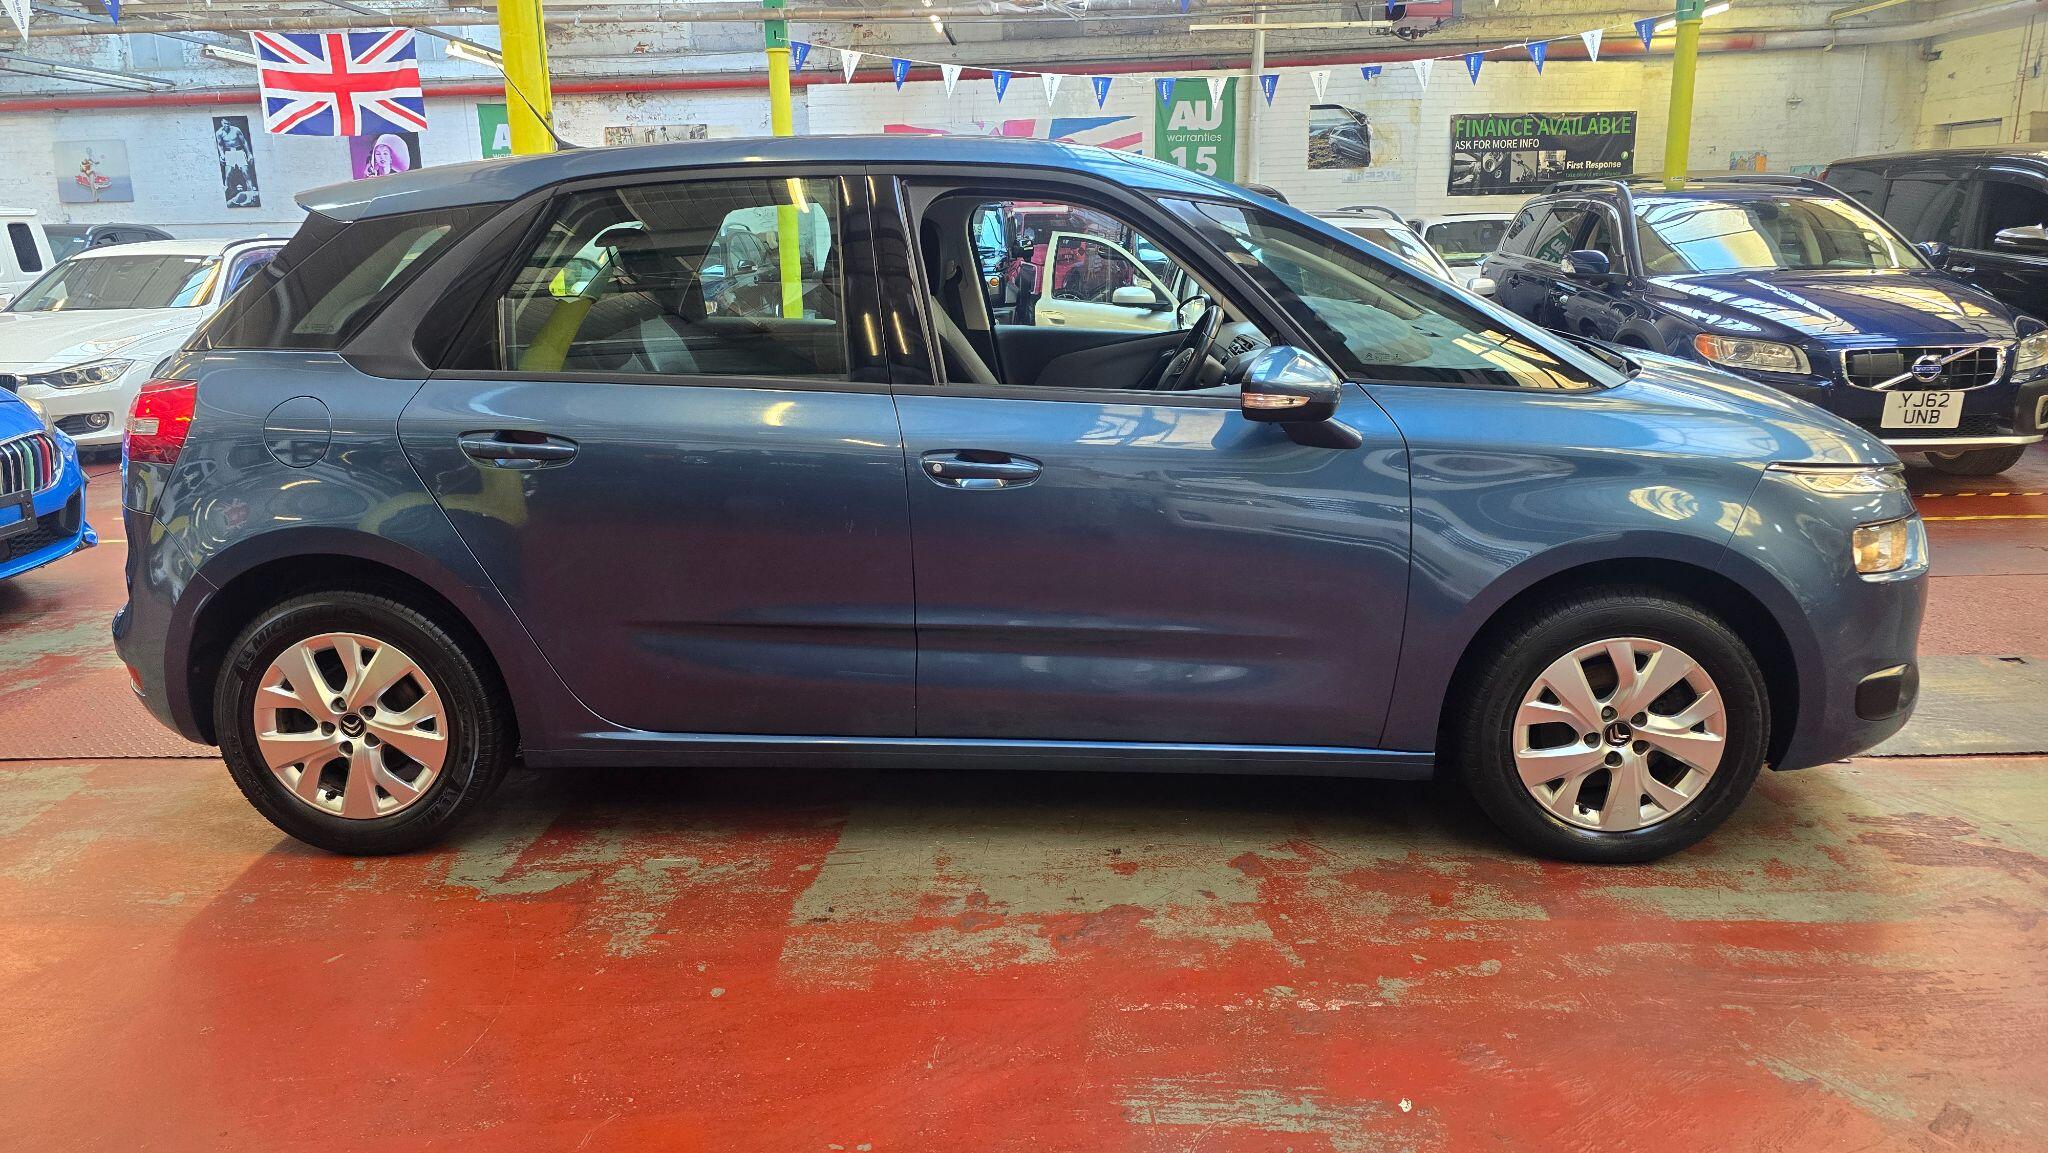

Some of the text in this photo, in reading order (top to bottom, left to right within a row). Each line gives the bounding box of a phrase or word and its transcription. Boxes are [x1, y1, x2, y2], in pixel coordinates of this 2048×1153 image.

[1167, 100, 1223, 131] AU
[1455, 116, 1632, 138] FINANCE AVAILABLE
[1166, 132, 1222, 142] warranties
[1455, 138, 1540, 150] ASK FOR MORE INFO
[1170, 146, 1217, 177] 15
[1566, 160, 1622, 170] First Response
[1902, 393, 1950, 408] YJ62
[1903, 409, 1941, 424] UNB
